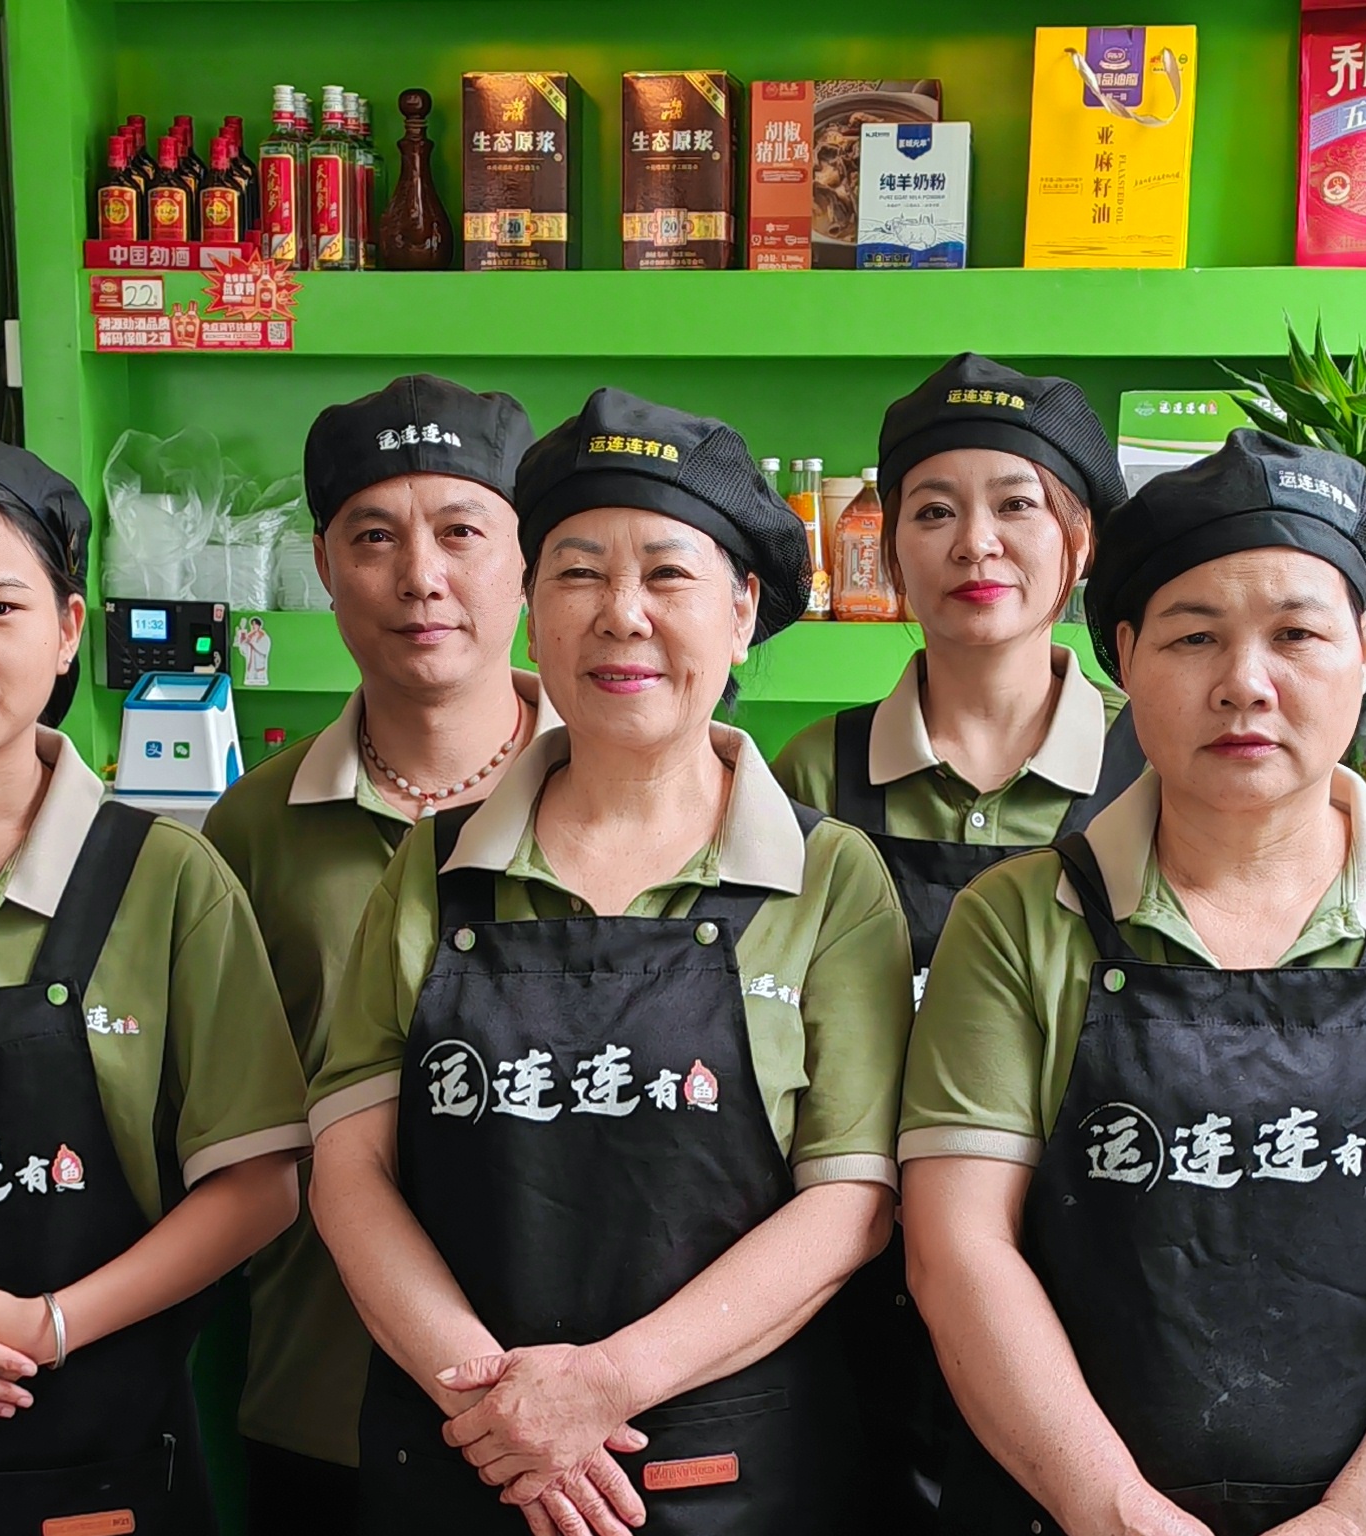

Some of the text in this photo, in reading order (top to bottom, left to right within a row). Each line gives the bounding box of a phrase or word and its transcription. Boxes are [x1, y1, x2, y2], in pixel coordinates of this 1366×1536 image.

[473, 131, 555, 152] 生态原浆
[632, 130, 713, 151] 生态原浆
[765, 121, 801, 142] 胡椒
[756, 143, 809, 163] 猪肚鸡
[879, 173, 946, 191] 纯羊奶粉
[1091, 124, 1115, 224] 亚麻籽油
[109, 245, 190, 267] 中国劲酒
[947, 389, 1024, 410] 运连连有鱼
[589, 435, 679, 462] 运连连有鱼
[135, 619, 164, 631] 11:32
[420, 1040, 718, 1124] 运连连有鱼
